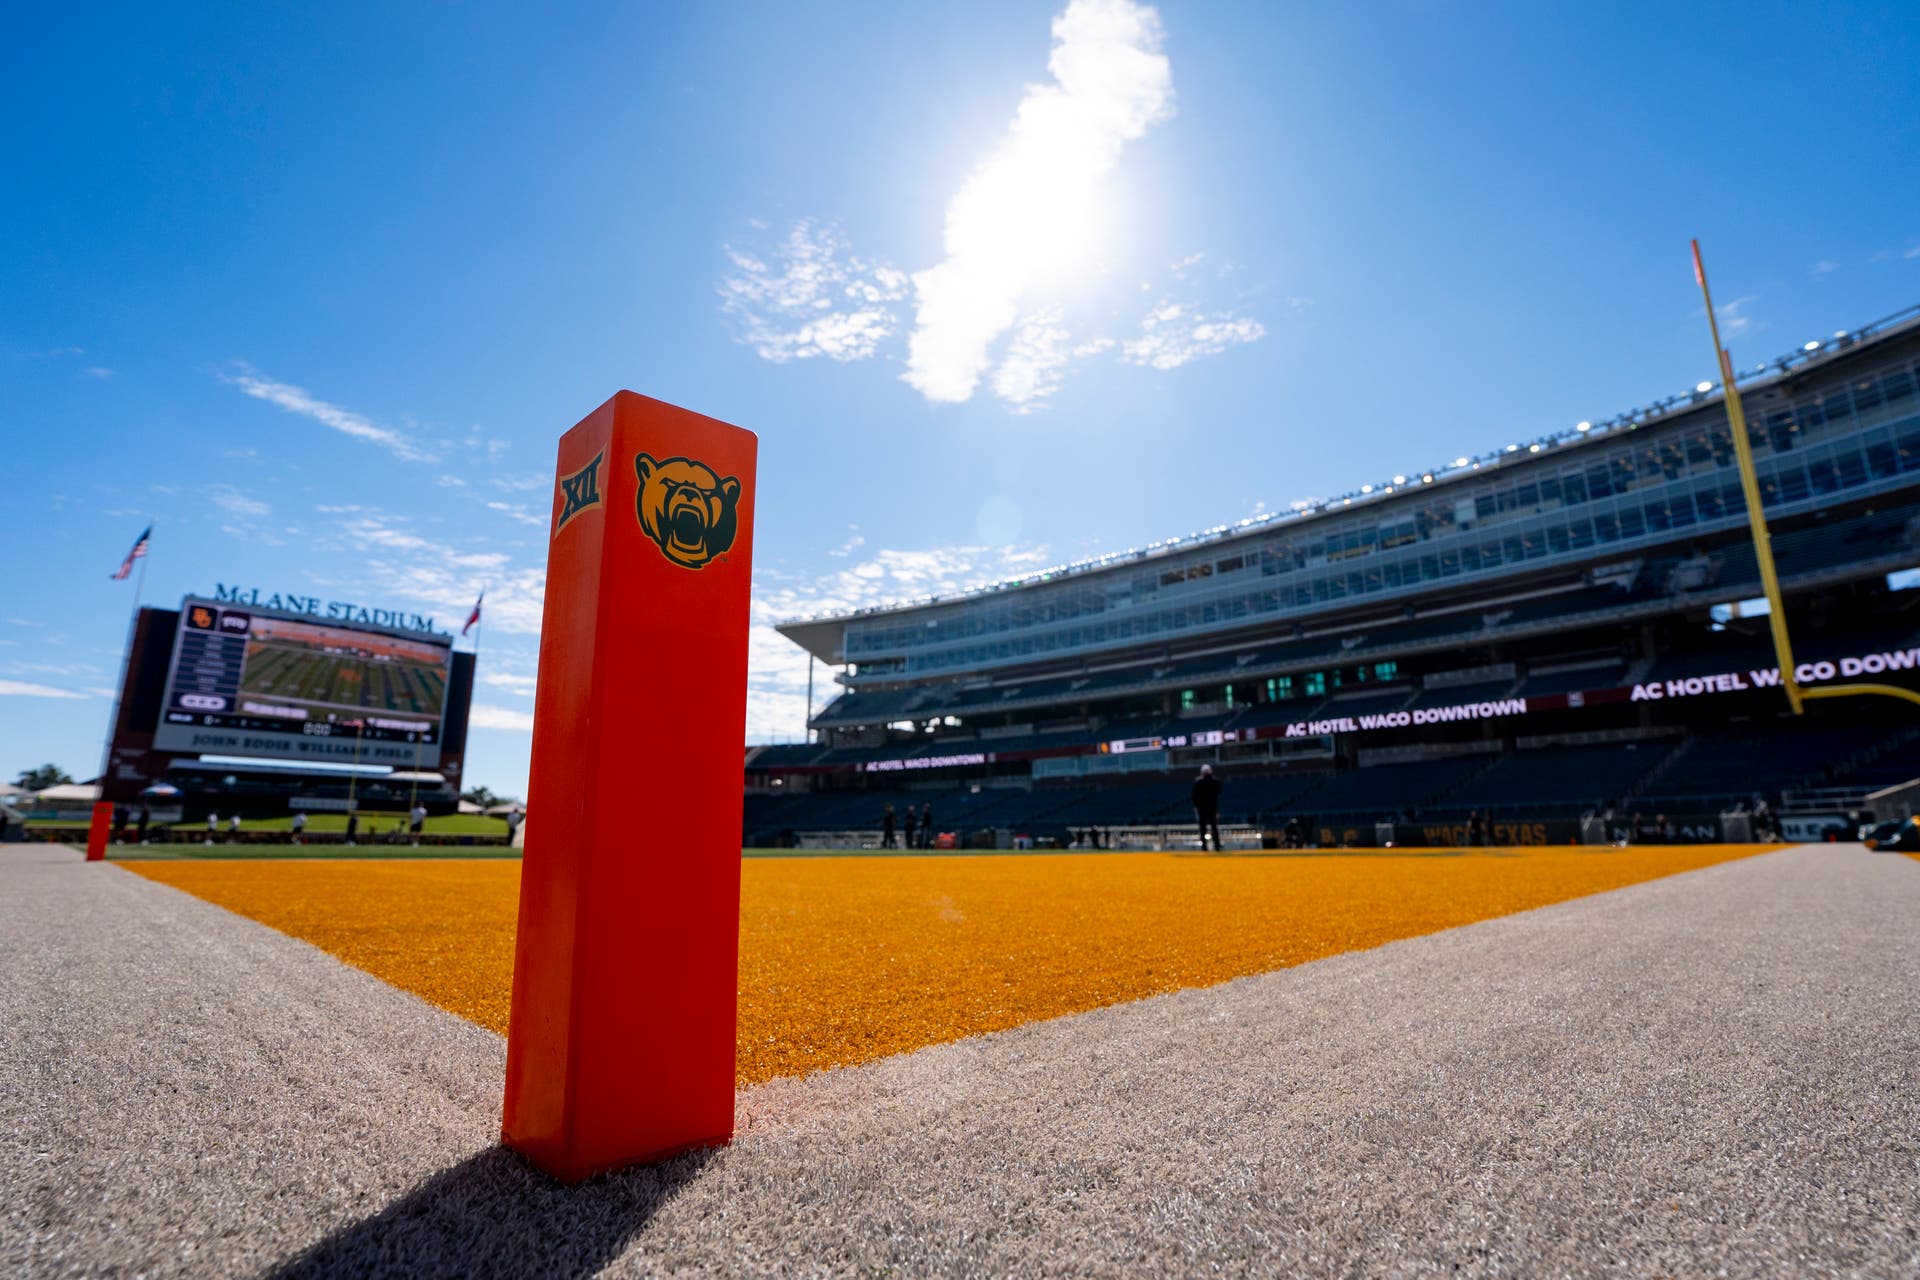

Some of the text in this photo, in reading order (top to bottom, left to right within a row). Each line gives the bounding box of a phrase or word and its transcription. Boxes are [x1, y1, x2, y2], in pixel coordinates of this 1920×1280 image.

[214, 583, 433, 632] McLANE STADIUM
[1630, 647, 1920, 701] AC HOTEL WCO DOW
[1285, 698, 1527, 737] AC HOTEL WACO DOWNTOWN
[192, 733, 414, 758] JOHN EDDIE WILLIAMS FIELD
[866, 753, 985, 771] AC HOTEL WACO DOWNTOWN
